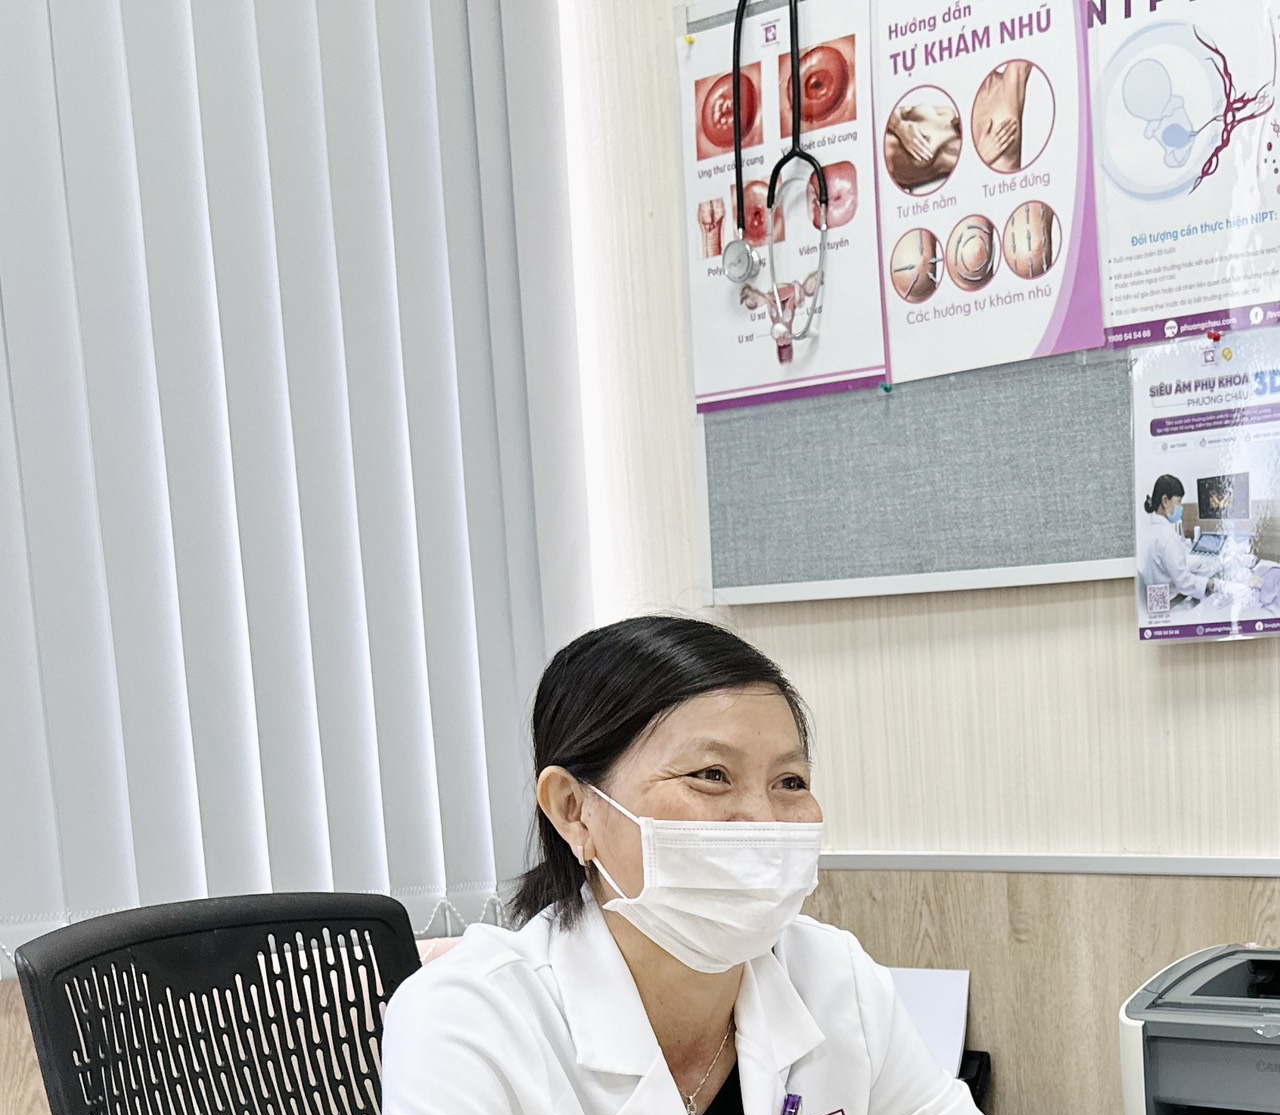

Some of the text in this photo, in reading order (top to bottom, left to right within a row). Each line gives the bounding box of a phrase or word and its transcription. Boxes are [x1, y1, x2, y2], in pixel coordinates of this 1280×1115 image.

[888, 1, 972, 40] Hướng dẫn
[890, 3, 1051, 77] TỰ KHÁM NHŨ
[838, 131, 857, 144] cung
[746, 155, 764, 167] cung
[982, 173, 1050, 198] Tư thế đứng
[897, 206, 909, 219] Tư
[912, 199, 929, 215] thế
[1131, 233, 1147, 246] Đối
[1149, 230, 1179, 243] tượng
[1180, 224, 1198, 237] cần
[1200, 221, 1224, 235] thực
[1251, 210, 1278, 224] NIPT:
[799, 245, 818, 257] Viêm
[906, 285, 1052, 325] Các hướng tự khám nhũ
[1108, 334, 1123, 343] 1900
[1124, 333, 1132, 341] 54
[1133, 331, 1141, 339] 54
[1150, 374, 1249, 398] SIÊU ÂM PHỤ KHOA
